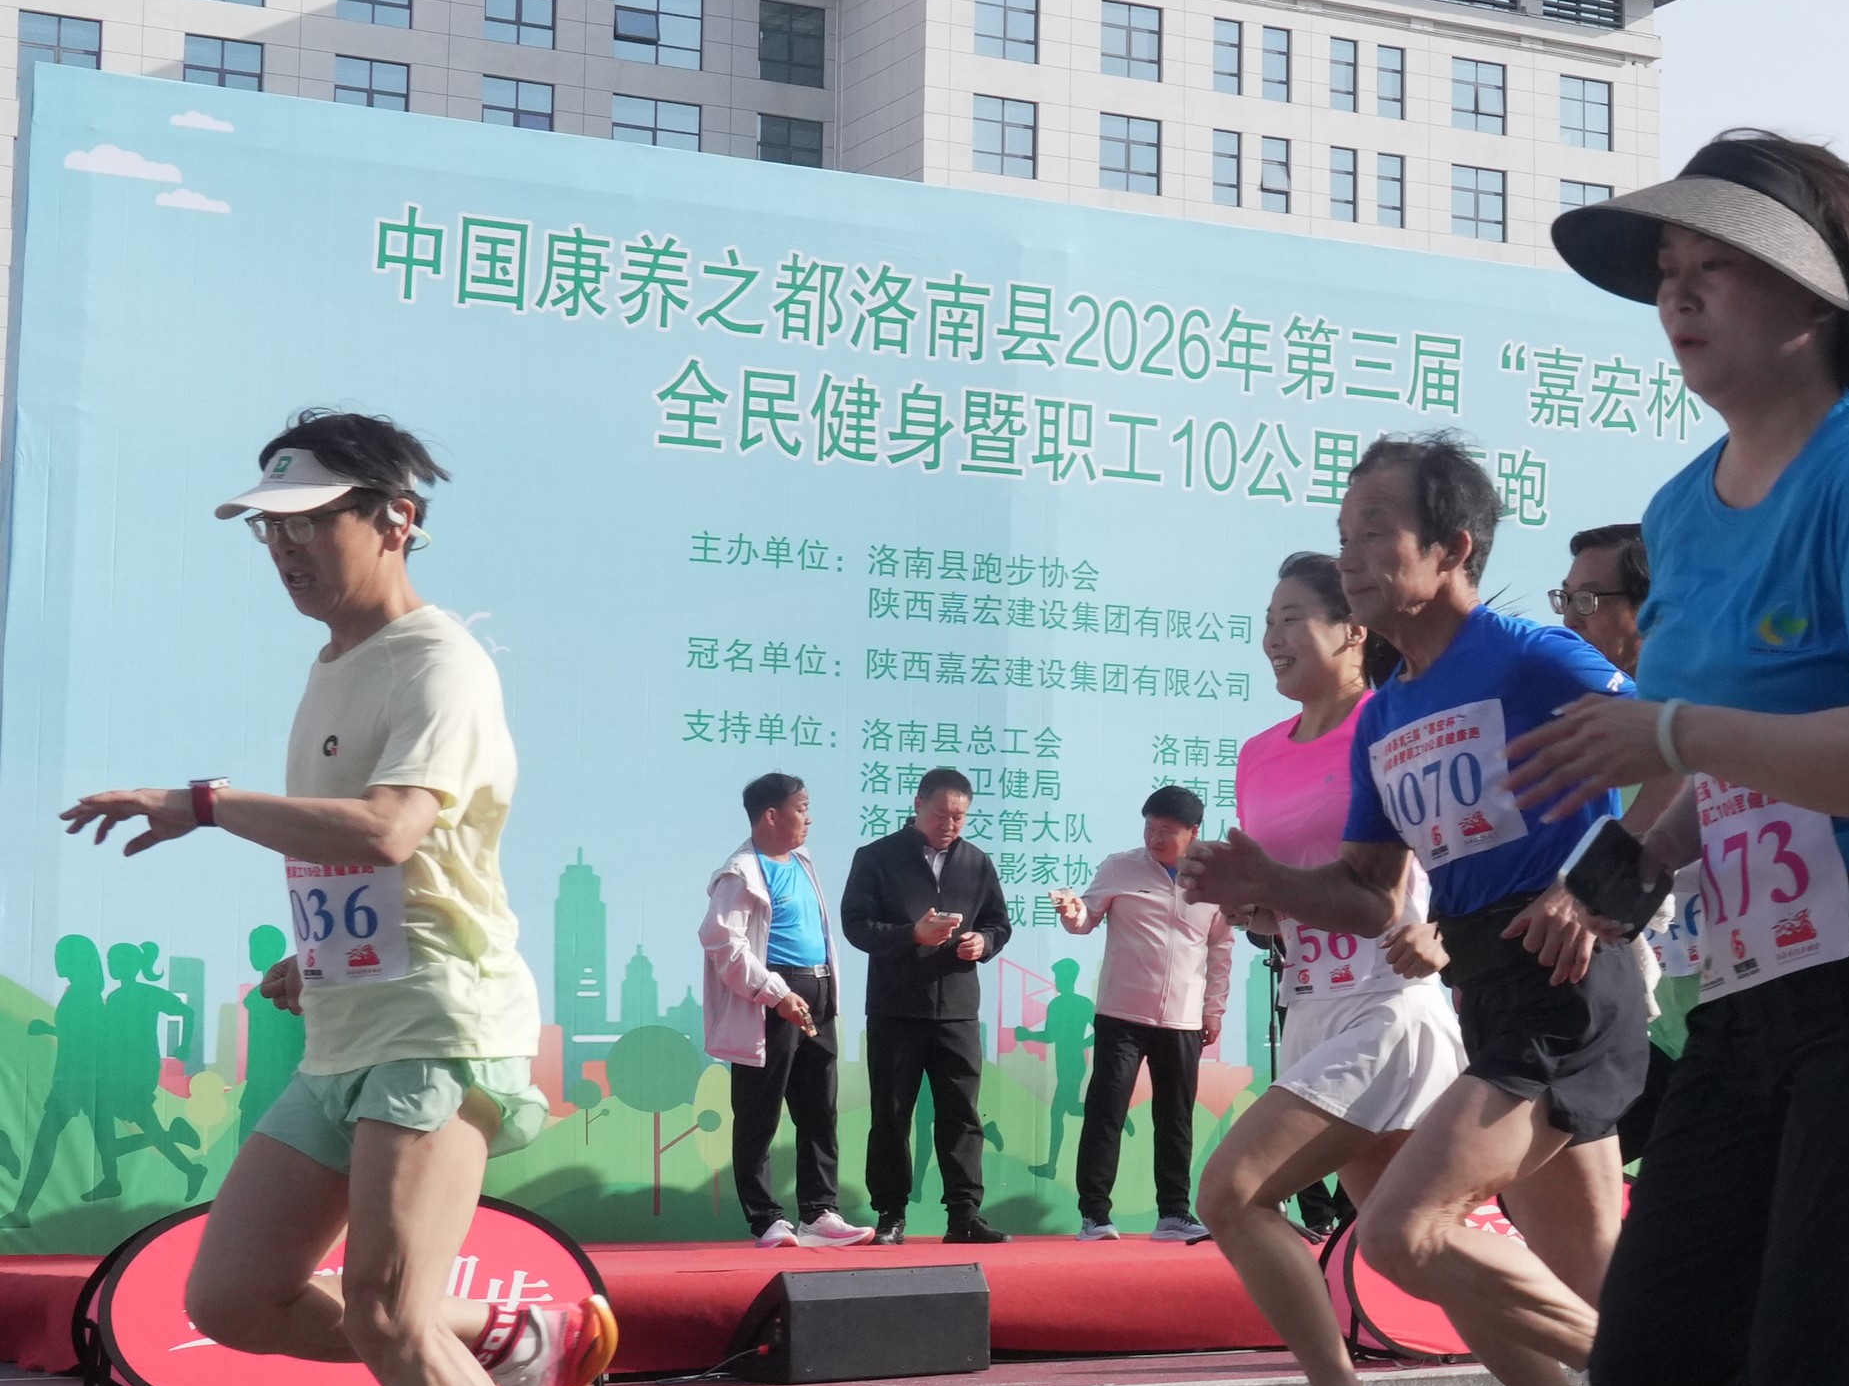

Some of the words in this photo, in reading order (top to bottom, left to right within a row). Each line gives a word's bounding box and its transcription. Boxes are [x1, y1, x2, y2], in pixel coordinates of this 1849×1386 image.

[655, 358, 1550, 528] 全民健身暨职工10公里跑
[867, 587, 1254, 647] 陕西嘉宏建设集团有限公司
[860, 760, 1061, 801] 洛南卫健局
[859, 804, 1093, 844] 洛交管大队
